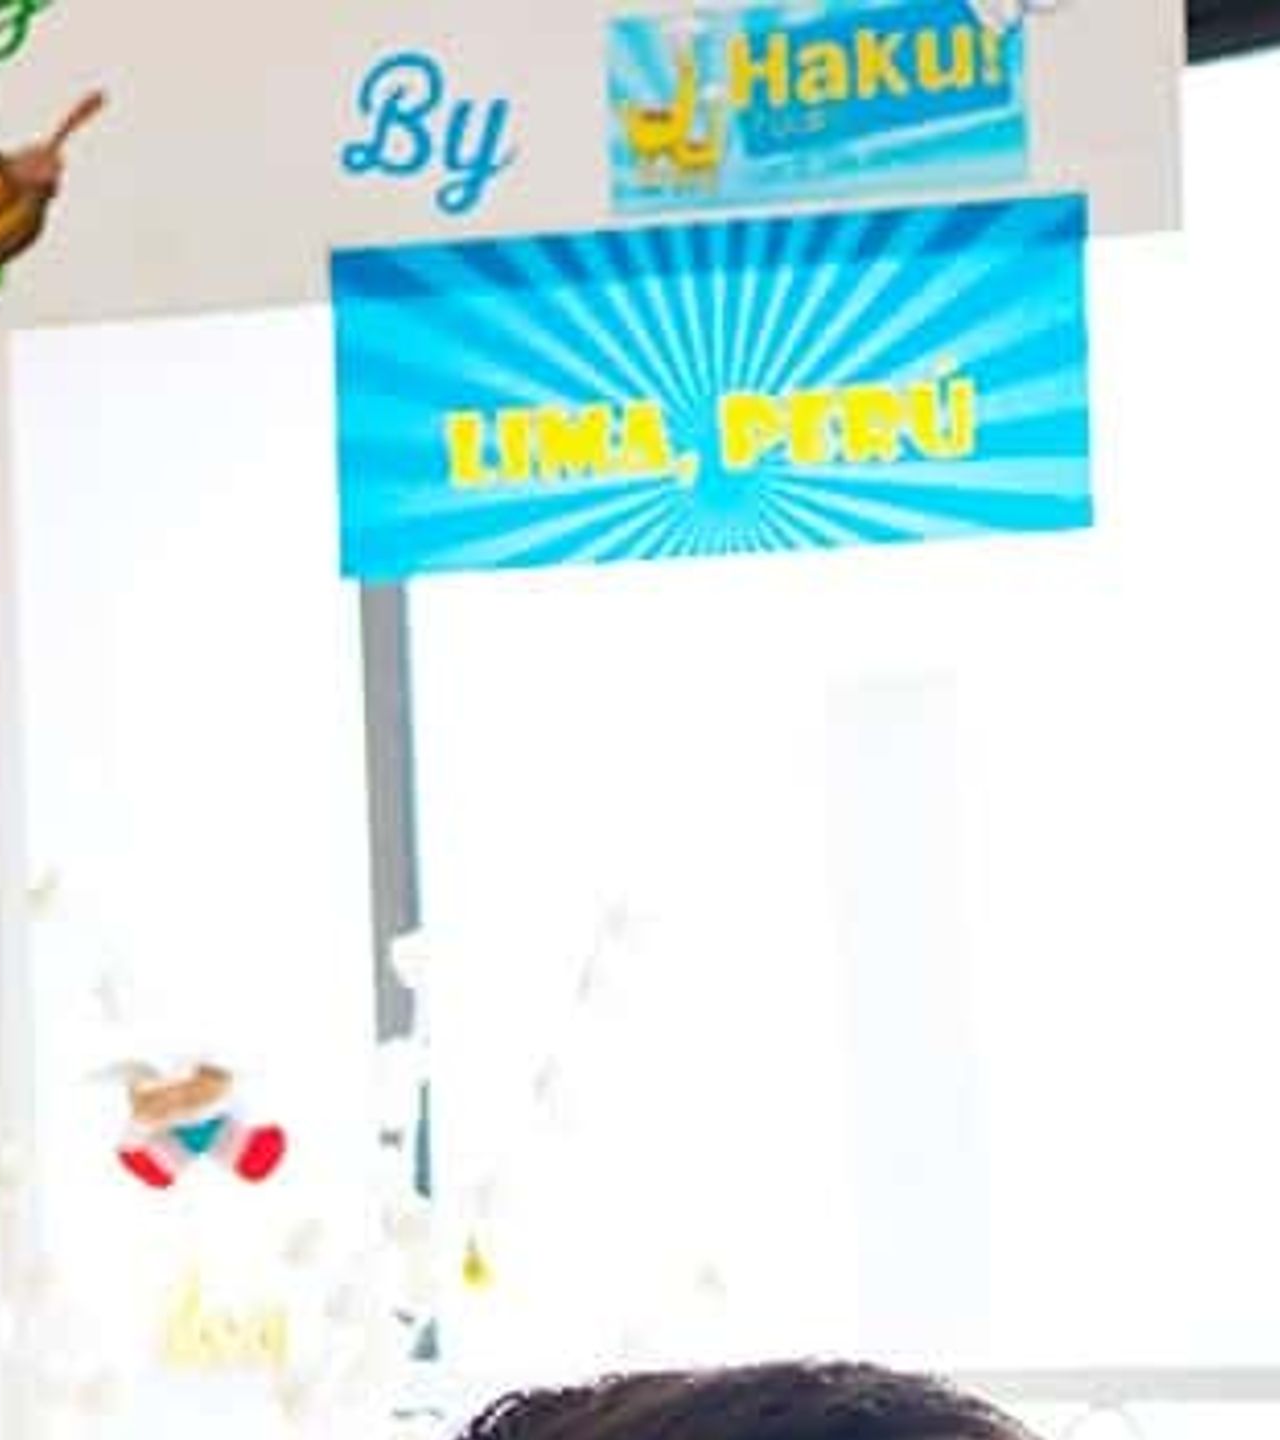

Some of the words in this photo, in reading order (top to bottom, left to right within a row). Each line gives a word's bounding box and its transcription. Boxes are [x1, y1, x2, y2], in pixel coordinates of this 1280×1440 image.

[342, 50, 518, 214] By
[446, 400, 698, 489] LIMA,
[718, 355, 976, 470] PERÚ
